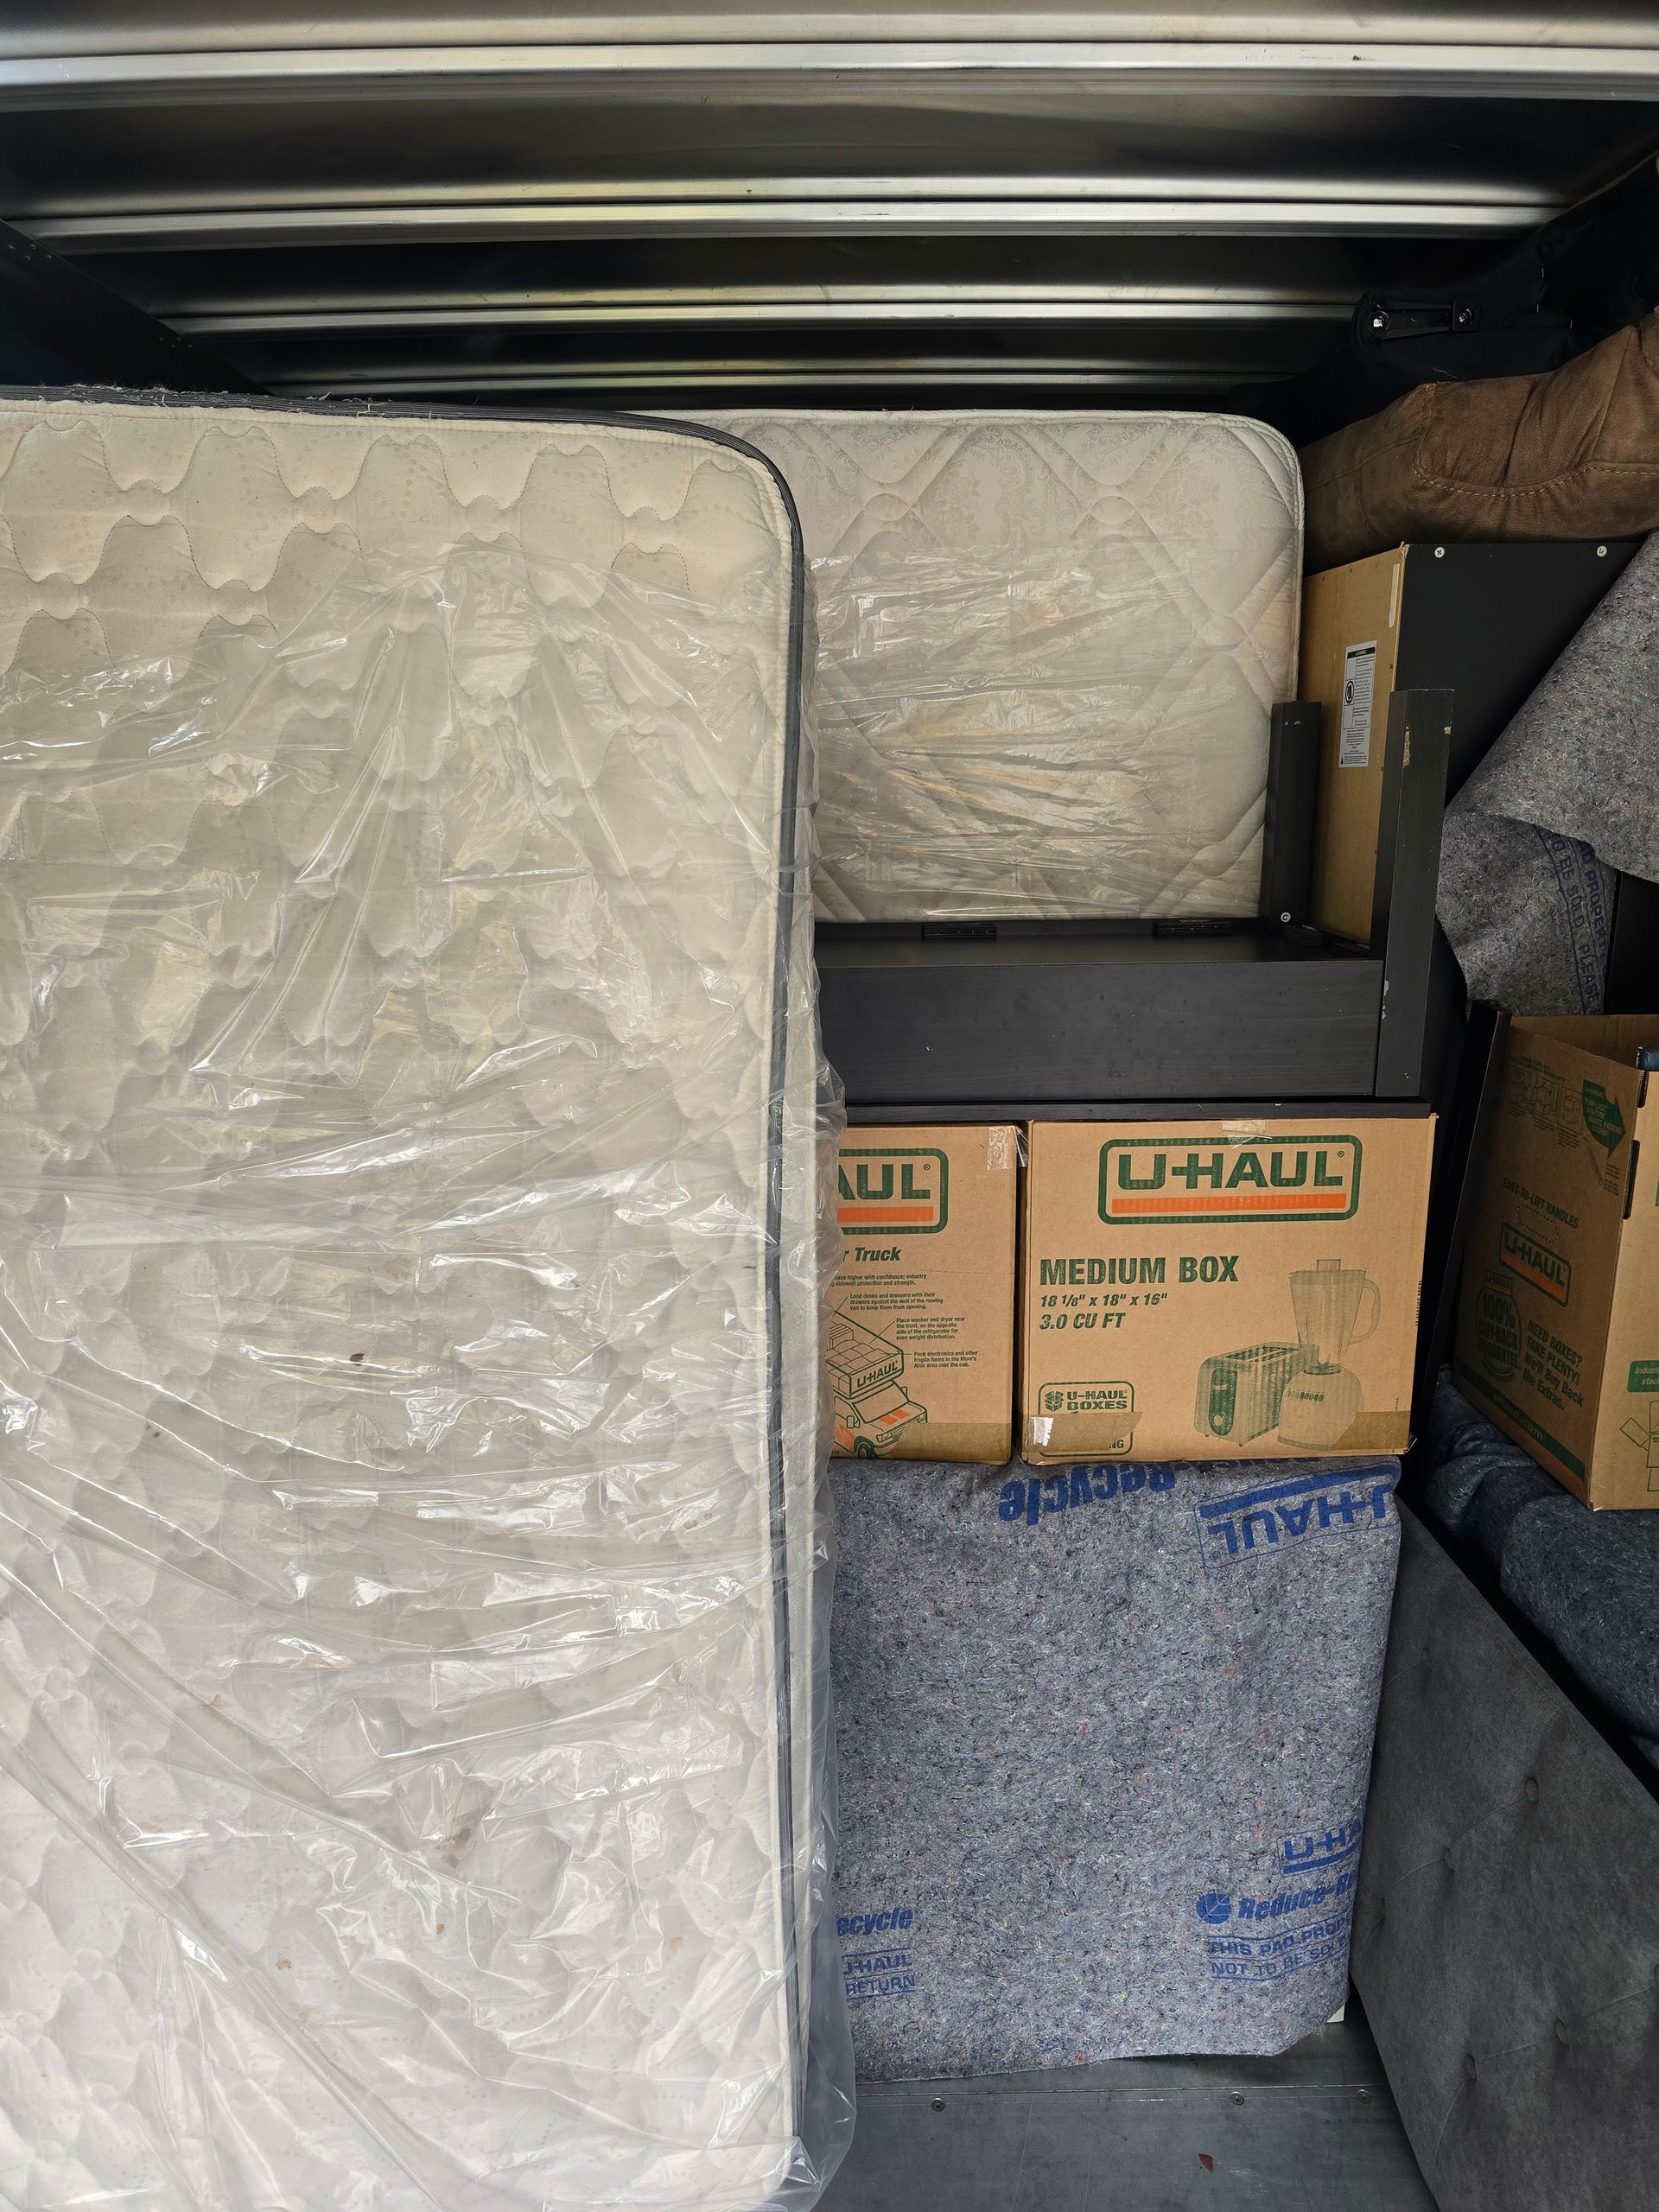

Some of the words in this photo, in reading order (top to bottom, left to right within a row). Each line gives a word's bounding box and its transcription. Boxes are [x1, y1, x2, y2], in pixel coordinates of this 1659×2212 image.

[1118, 1150, 1344, 1190] U-HAUL
[1503, 1176, 1546, 1209] EASY-TO-LIFT
[1546, 1199, 1579, 1229] HANDLES
[855, 1247, 902, 1262] Truck
[1503, 1230, 1565, 1286] U-HAUL
[1039, 1257, 1166, 1286] MEDIUM
[1179, 1255, 1240, 1283] BOX
[1040, 1295, 1058, 1307] 18
[1089, 1297, 1098, 1306] x
[1129, 1296, 1138, 1306] x
[1483, 1293, 1515, 1329] 100%
[1039, 1314, 1068, 1330] 3.0
[1072, 1313, 1098, 1329] CU
[1103, 1313, 1126, 1328] FT
[1528, 1319, 1548, 1343] NEED
[1550, 1335, 1583, 1363] BOXES?
[857, 1362, 898, 1388] U-HAUL
[1527, 1335, 1546, 1359] TAKE
[1547, 1349, 1580, 1386] PLENTY!
[1067, 1390, 1127, 1400] U-HAUL
[1522, 1368, 1535, 1387] the
[1537, 1381, 1564, 1410] Extras.
[1524, 1351, 1543, 1376] We'll
[1545, 1368, 1560, 1390] Buy
[1561, 1381, 1584, 1408] Back
[1067, 1401, 1128, 1410] BOXES
[1493, 1391, 1543, 1440] uhaul.com
[1284, 1819, 1362, 1860] U-HA
[836, 1908, 912, 1936] ecycle
[1209, 1942, 1252, 1955] THIS
[1260, 1936, 1294, 1955] PAD
[1211, 1962, 1249, 1975] NOT
[1256, 1963, 1276, 1976] TO
[1284, 1953, 1302, 1969] BE
[846, 1974, 915, 1995] RETURN
